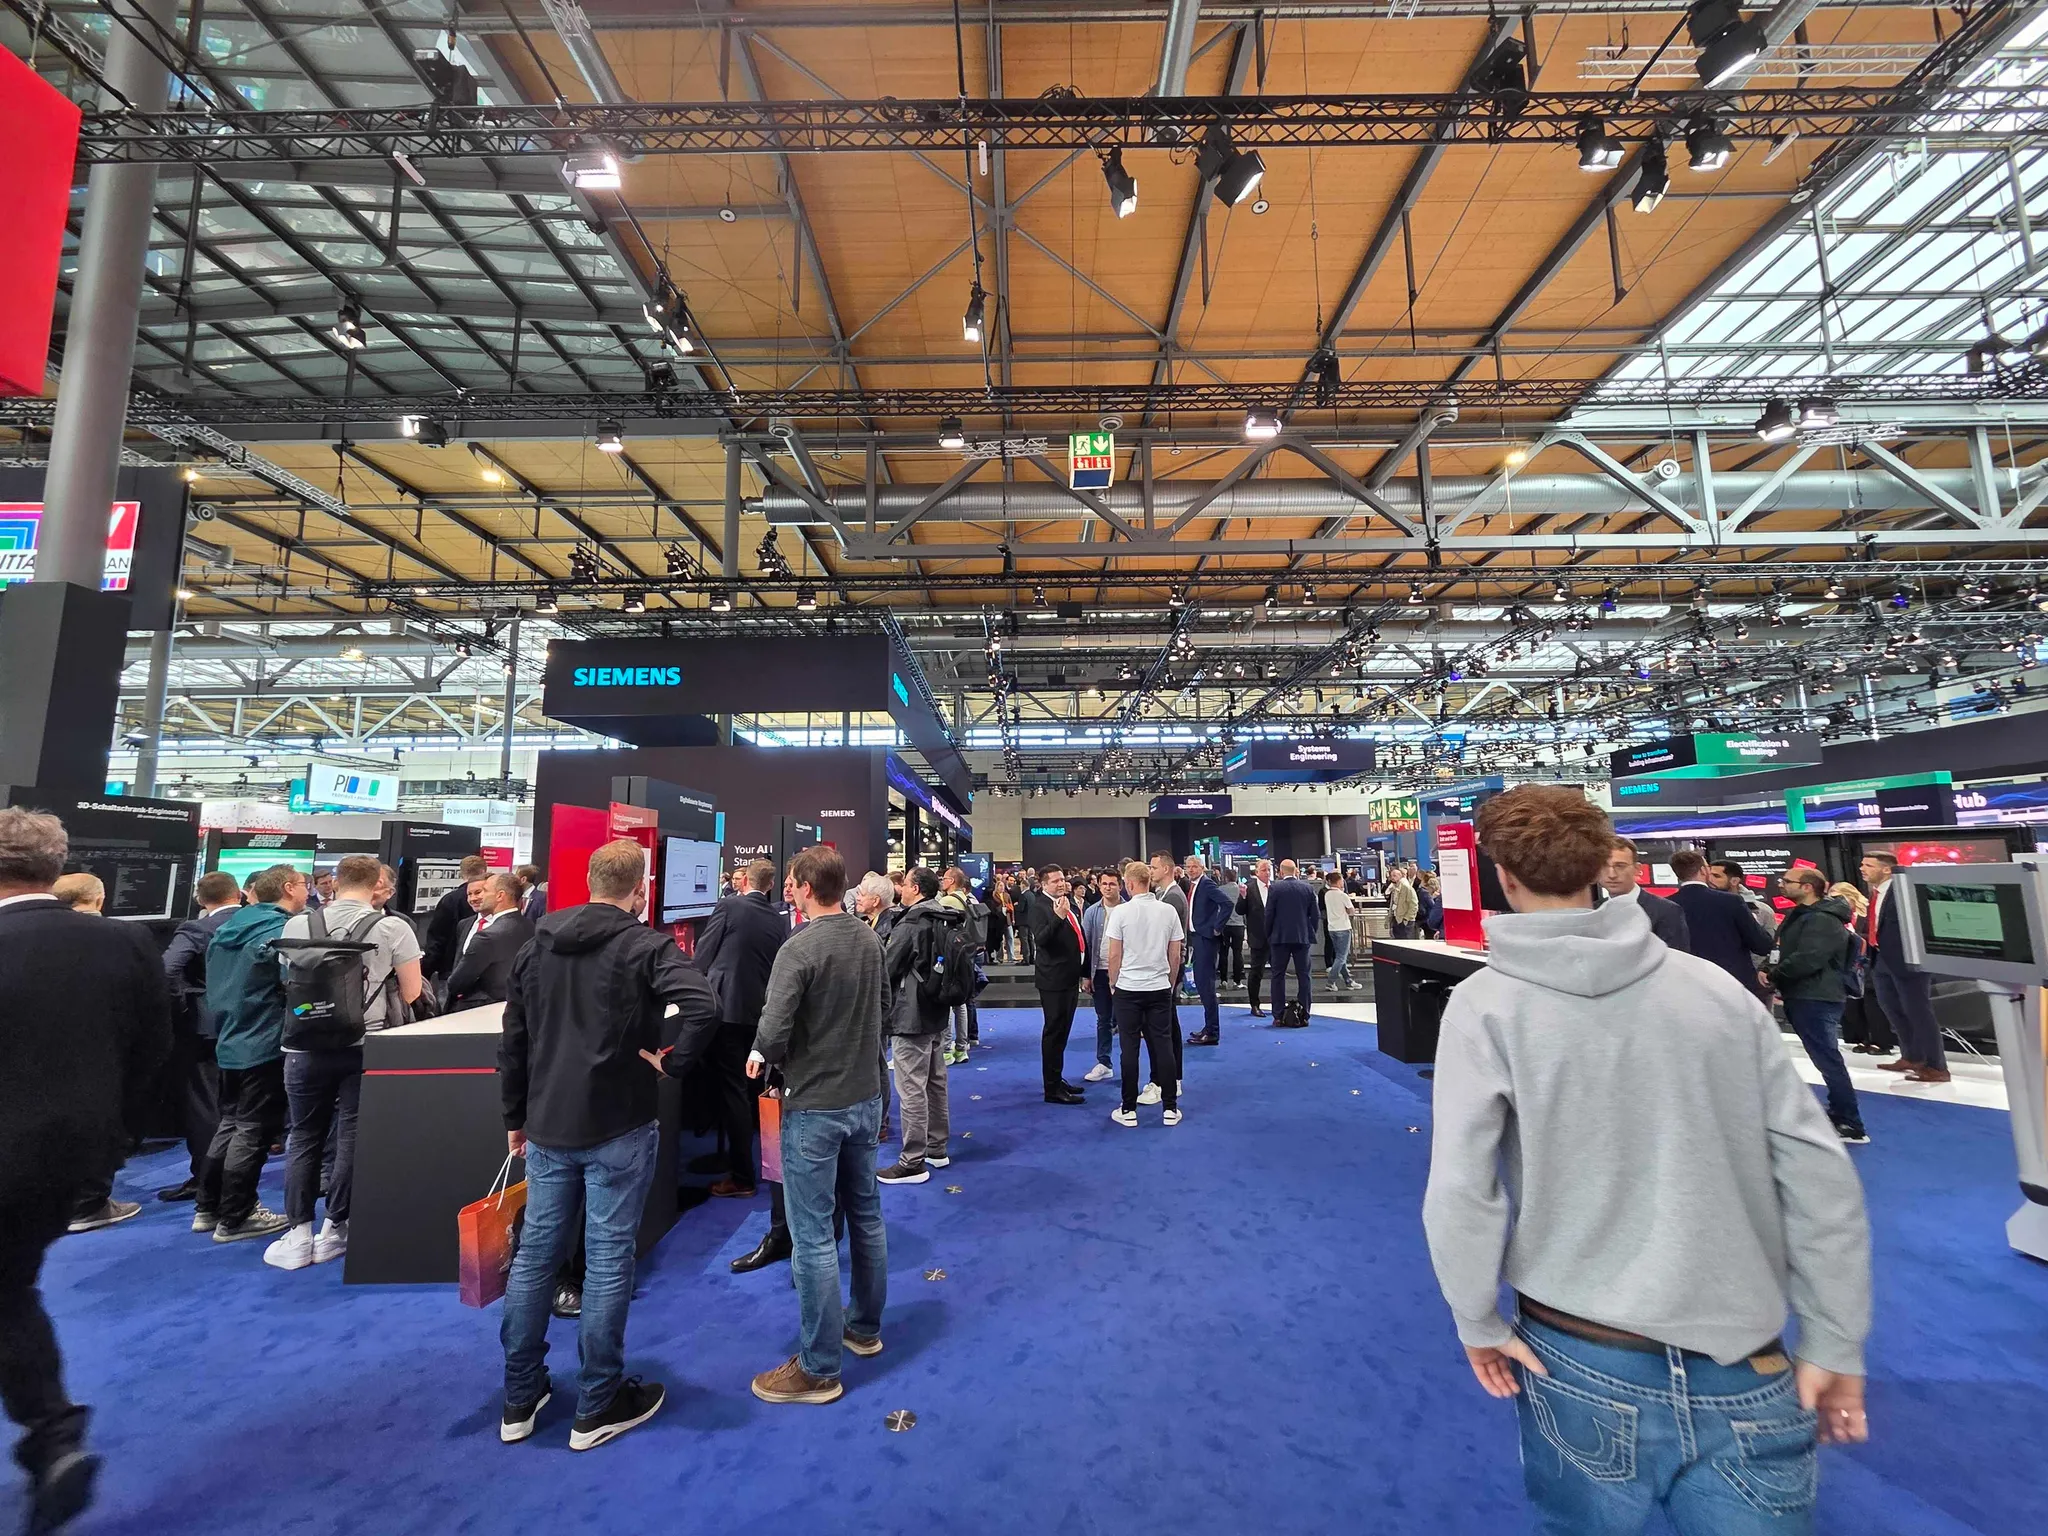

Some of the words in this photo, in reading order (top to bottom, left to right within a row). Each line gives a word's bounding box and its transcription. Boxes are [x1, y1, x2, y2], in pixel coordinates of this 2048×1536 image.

[0, 553, 37, 570] ITTA
[106, 557, 130, 569] AN
[573, 667, 681, 686] SIEMENS
[1726, 740, 1782, 748] Electrification
[1782, 740, 1790, 748] &
[1297, 745, 1331, 754] Systems
[1740, 748, 1778, 757] Buildings
[1289, 752, 1338, 762] Engineering
[333, 774, 350, 793] PI
[1619, 783, 1660, 796] SIEMENS
[77, 801, 189, 817] 3D-Schaltschrank-Engineering
[820, 809, 856, 818] SIEMENS
[1030, 827, 1066, 836] SIEMENS
[734, 845, 755, 854] Your
[757, 845, 768, 853] AI
